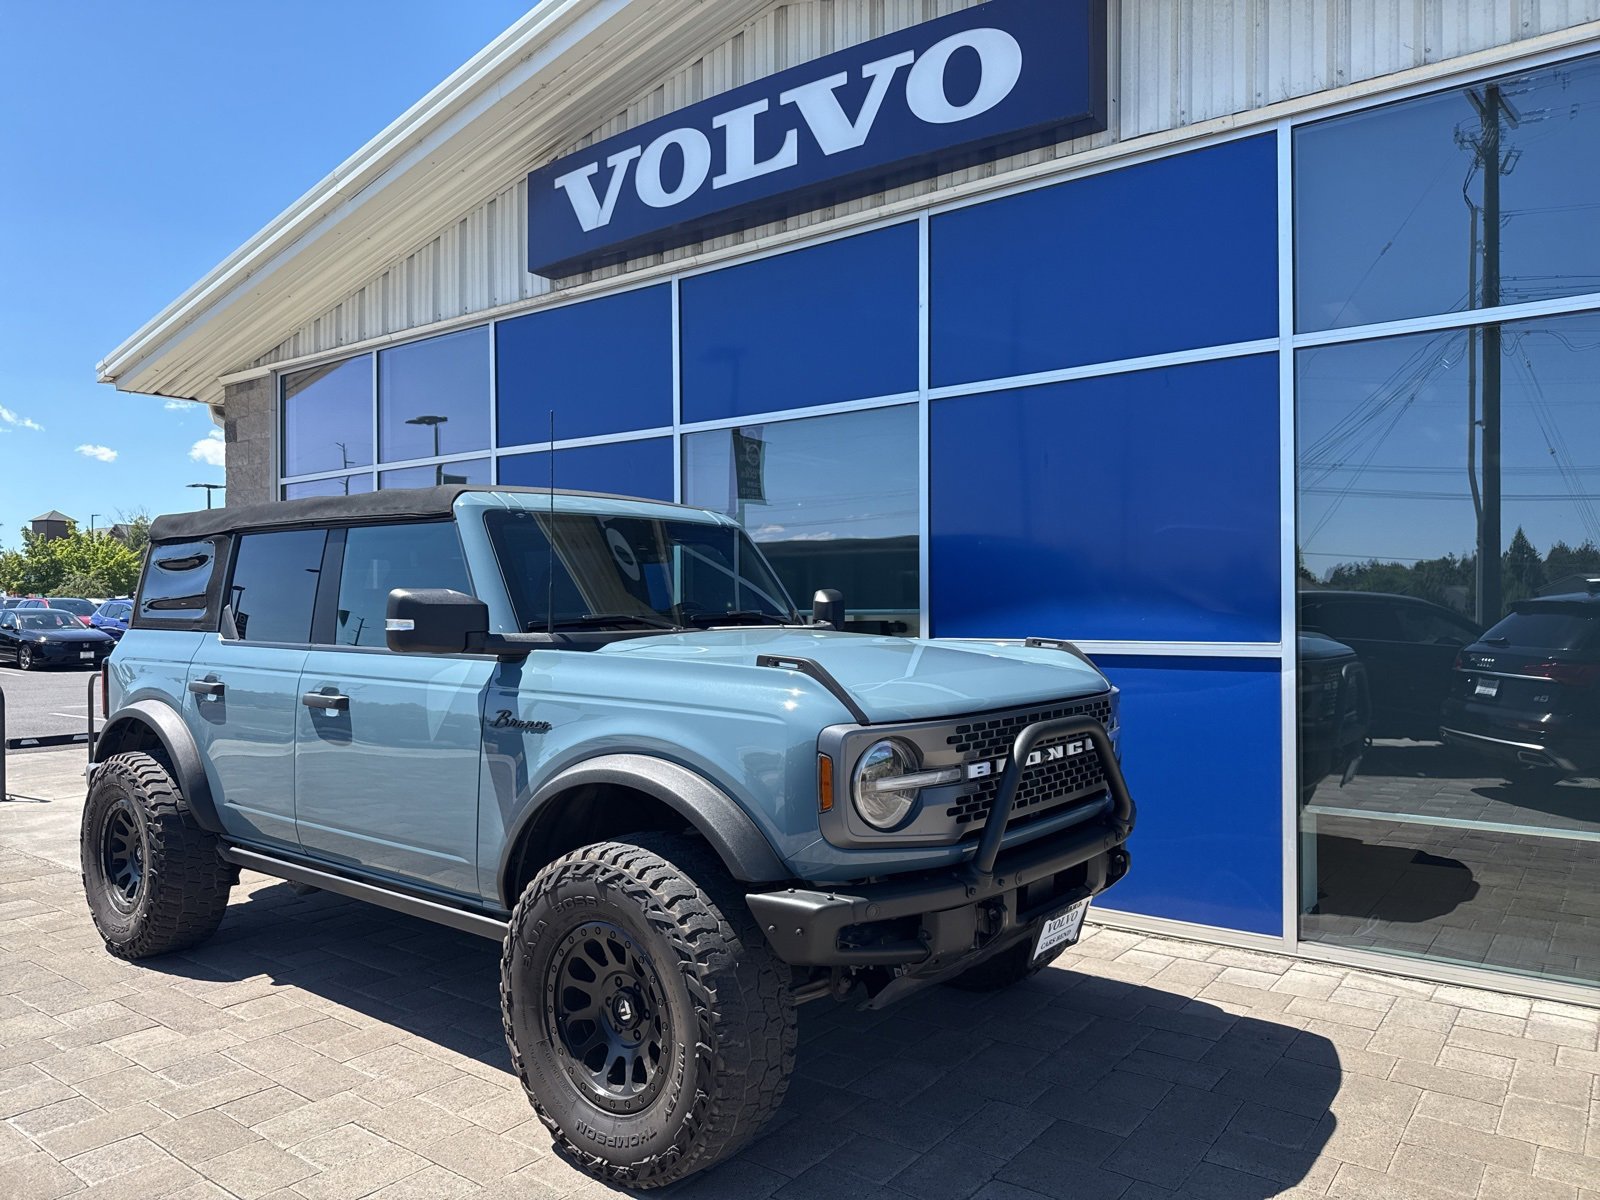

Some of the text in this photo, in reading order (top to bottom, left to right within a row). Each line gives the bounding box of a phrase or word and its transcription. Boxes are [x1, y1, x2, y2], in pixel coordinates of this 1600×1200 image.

[554, 27, 1022, 232] VOLVO
[489, 709, 553, 731] Bronco
[523, 895, 598, 967] BAJA BOSS
[1040, 936, 1057, 950] CARS
[1047, 910, 1079, 934] VOLVO
[575, 1041, 686, 1149] MICKEY THOMPSON
